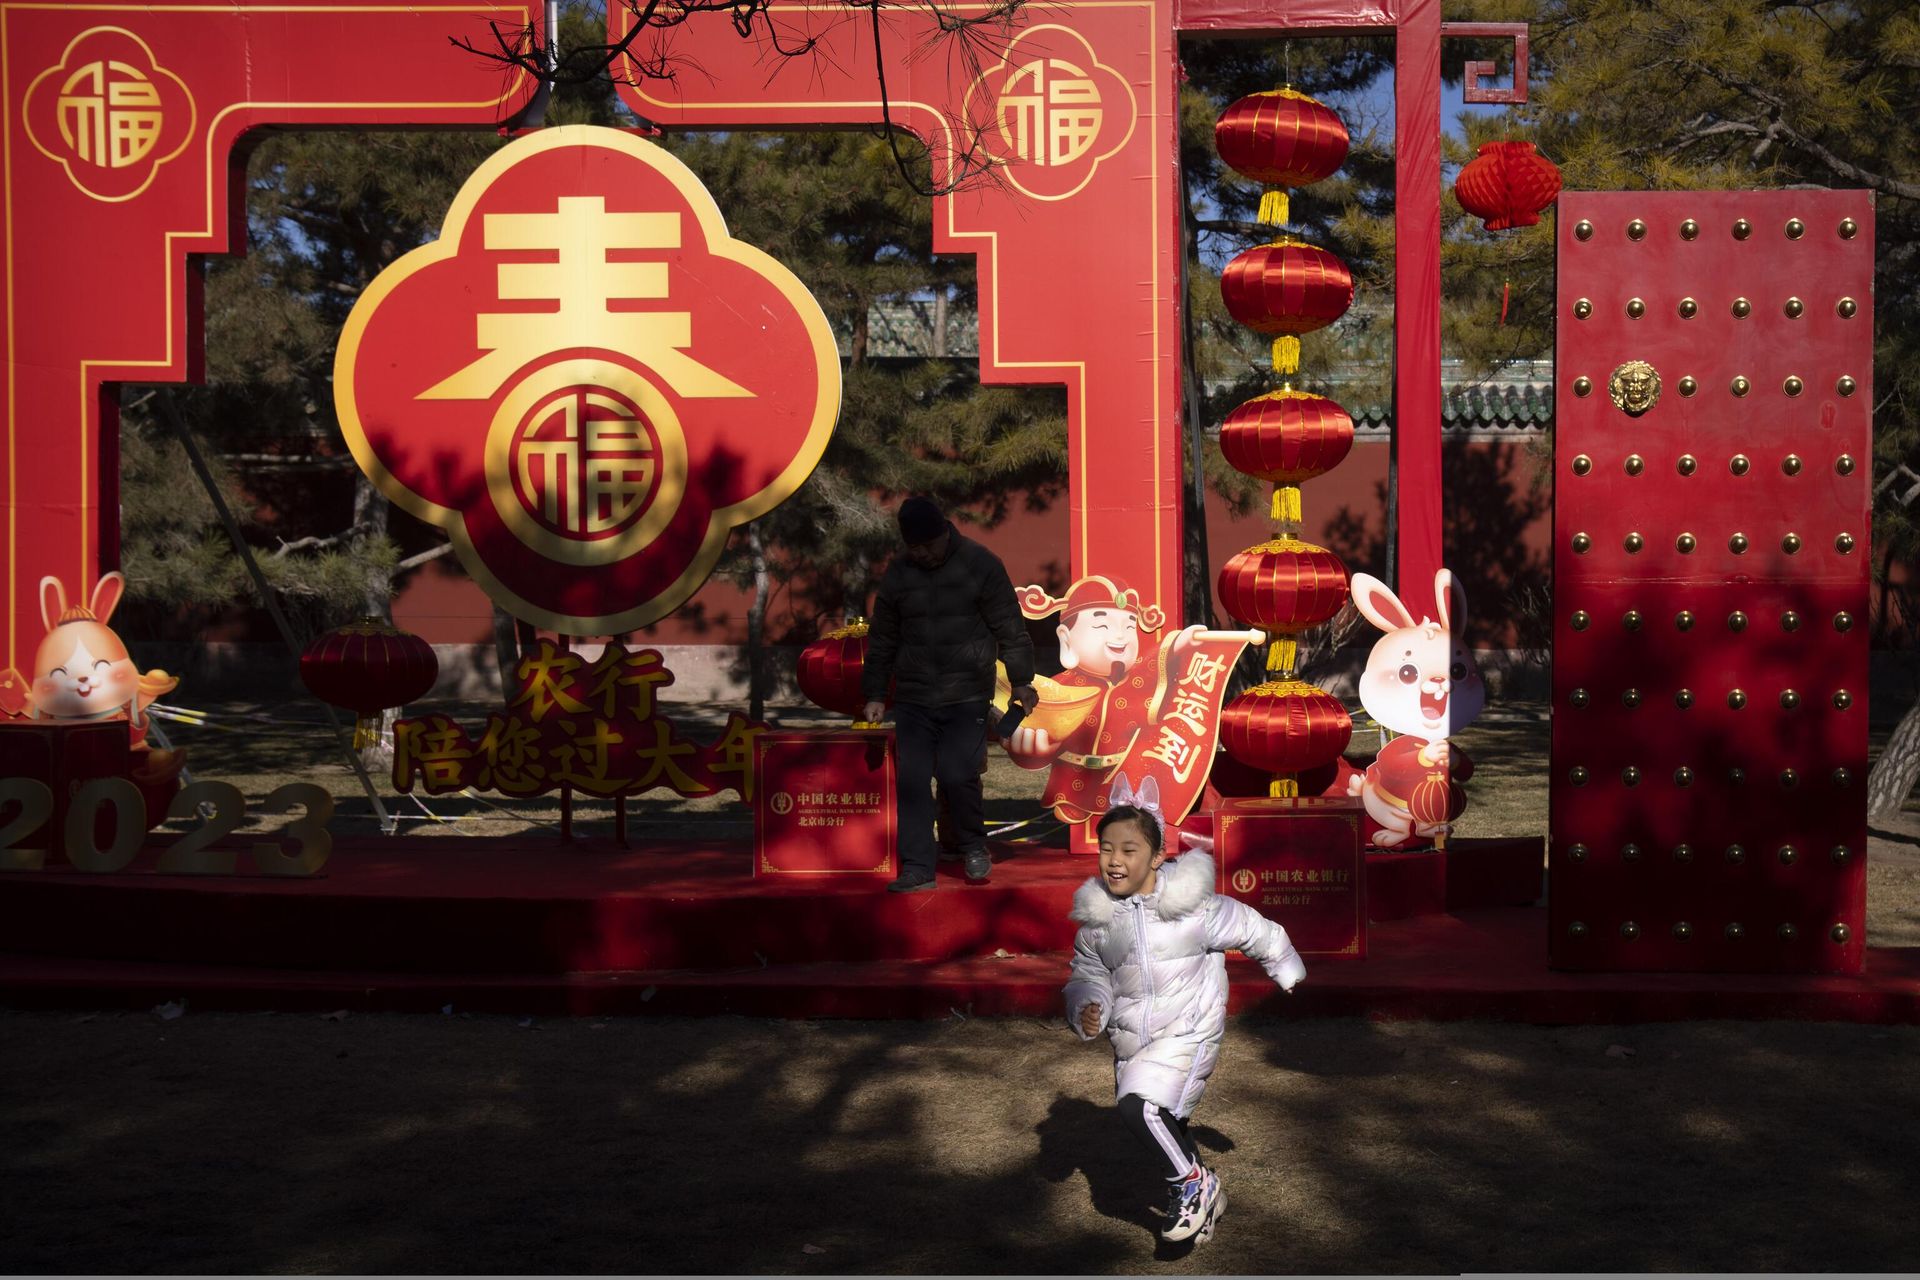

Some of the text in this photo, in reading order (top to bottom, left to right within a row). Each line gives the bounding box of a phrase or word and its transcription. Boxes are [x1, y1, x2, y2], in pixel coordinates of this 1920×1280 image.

[57, 60, 163, 168] 福
[997, 58, 1103, 167] 福
[518, 392, 654, 532] 福
[511, 645, 673, 724] 农行
[1141, 651, 1227, 784] 财运到
[394, 714, 767, 802] 陪您过大年
[797, 793, 880, 805] 中国农业银行
[0, 776, 334, 875] 2023
[798, 816, 845, 827] 北京市分行
[1261, 869, 1350, 883] 中国农业银行
[1261, 894, 1311, 905] 北京市分行
